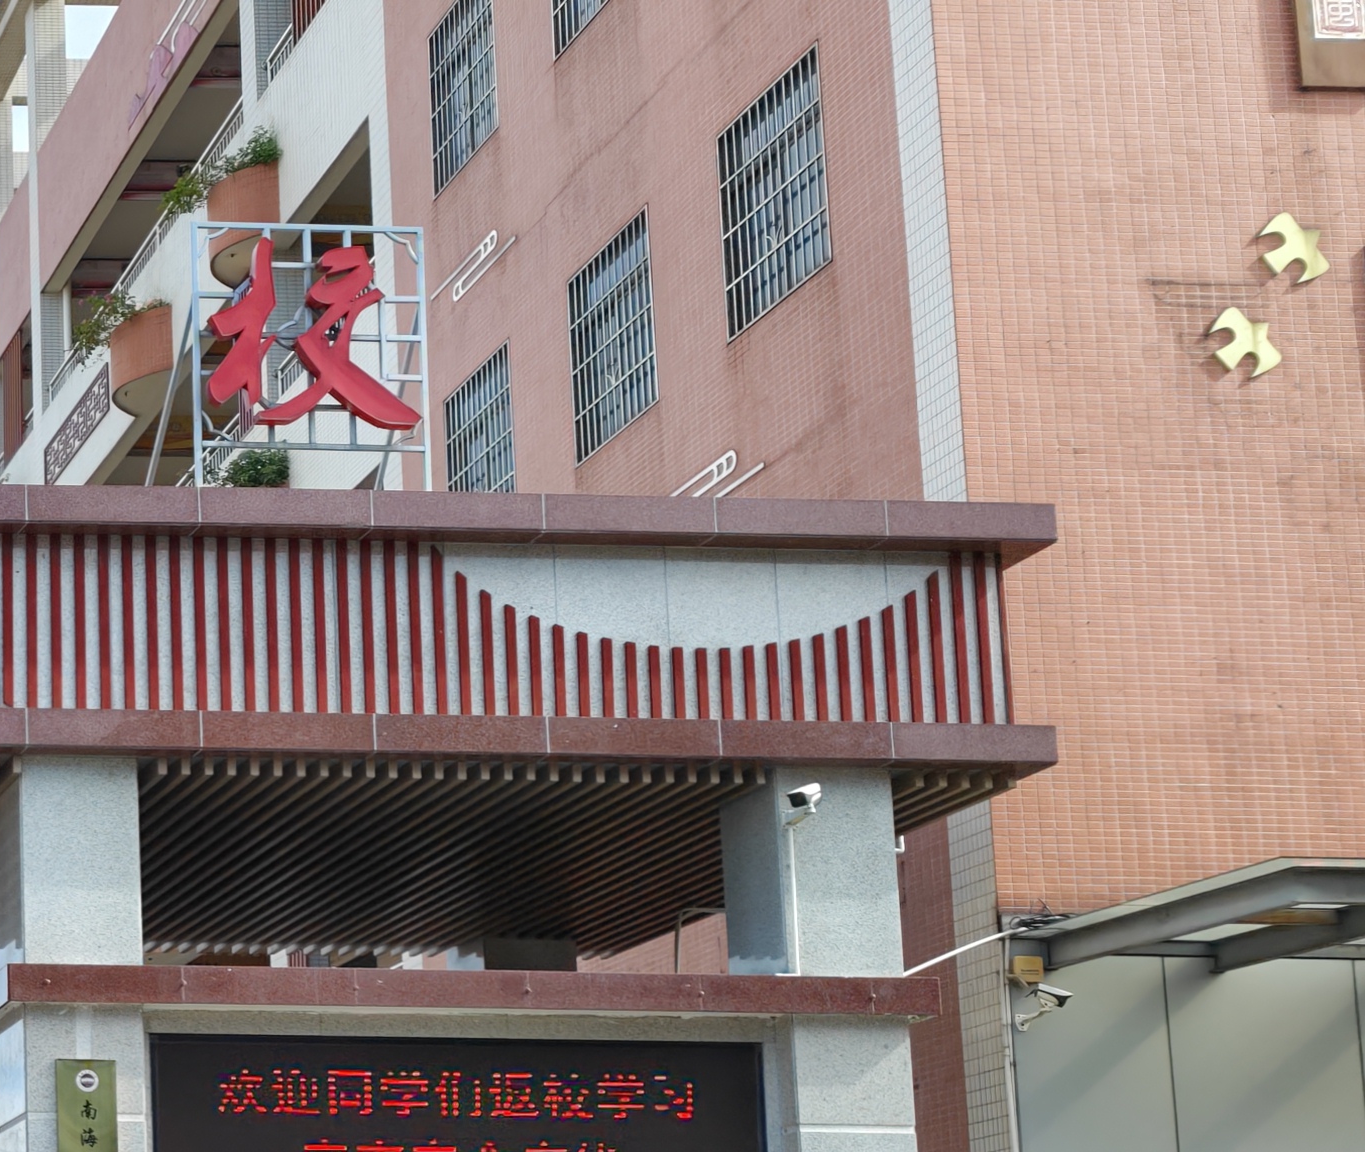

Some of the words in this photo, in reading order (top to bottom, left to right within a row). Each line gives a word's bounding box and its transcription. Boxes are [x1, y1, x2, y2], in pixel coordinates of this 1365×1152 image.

[217, 1068, 695, 1121] 欢迎同学们返校学习
